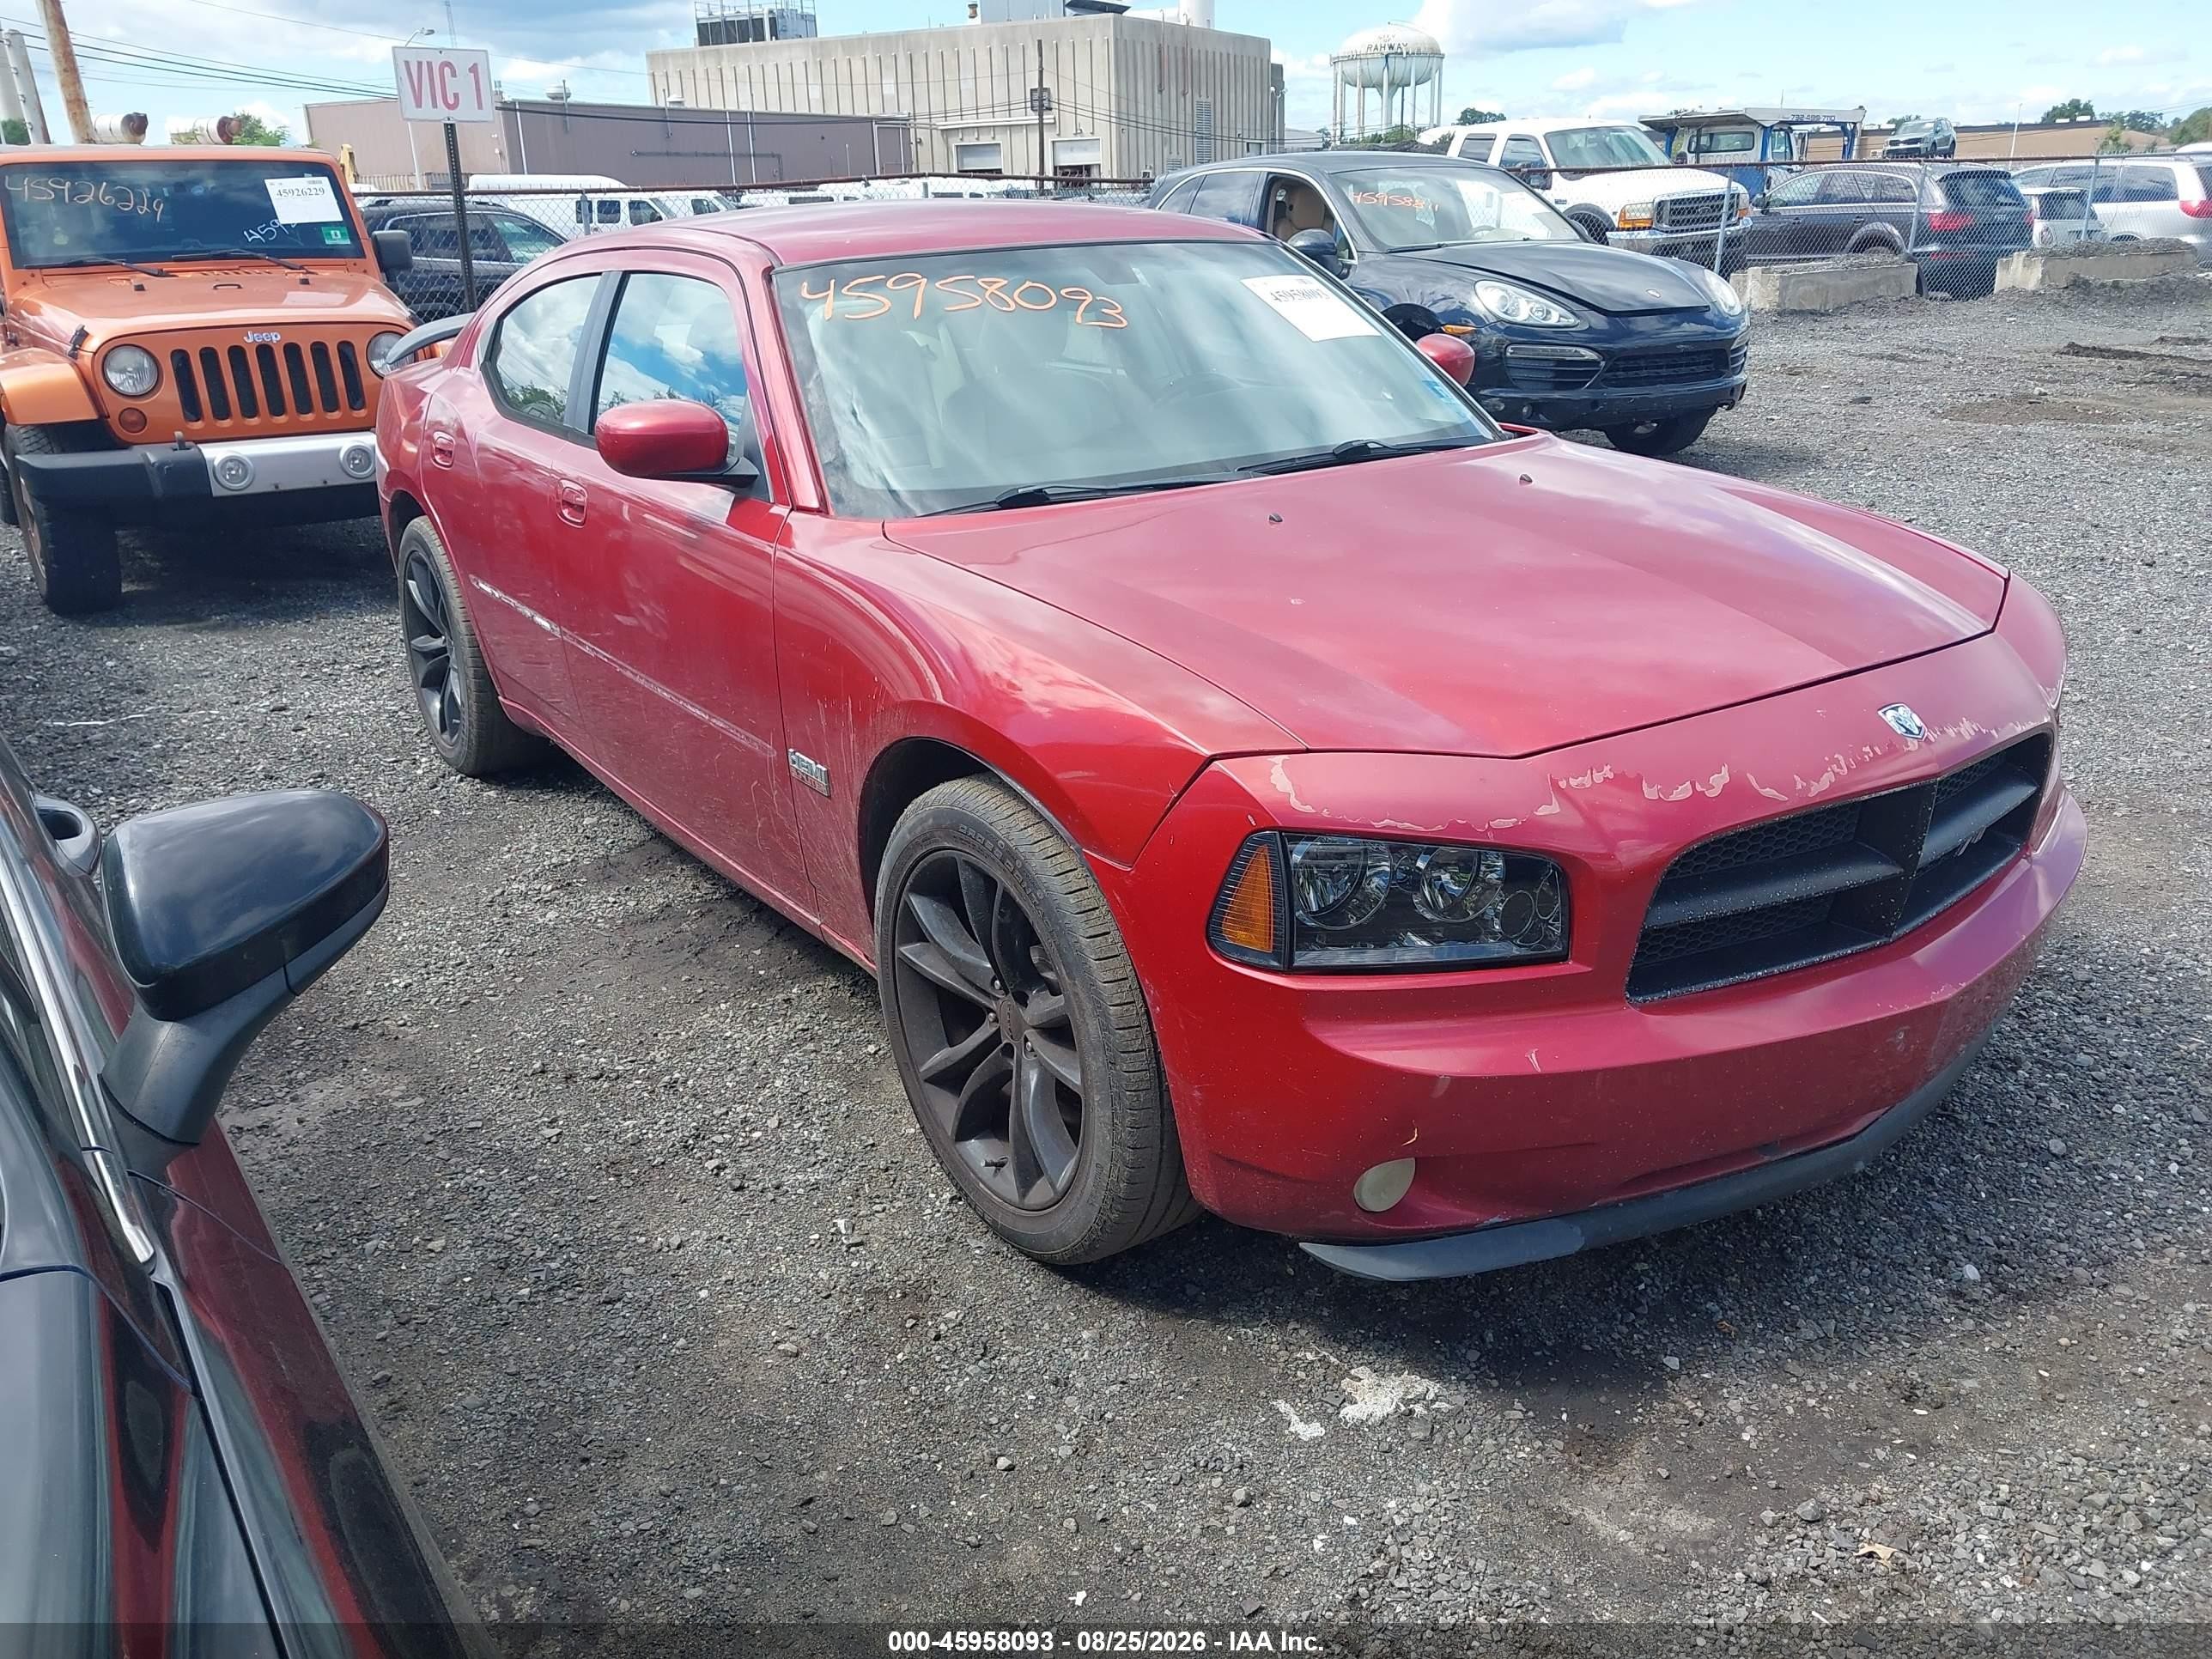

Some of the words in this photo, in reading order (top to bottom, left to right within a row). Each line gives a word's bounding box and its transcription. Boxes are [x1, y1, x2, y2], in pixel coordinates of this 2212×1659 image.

[1367, 42, 1408, 52] RAHWAY
[404, 60, 459, 111] VIC
[468, 63, 483, 111] 1
[5, 175, 164, 222] 45926229
[276, 187, 325, 198] 45926229
[243, 219, 298, 243] 459
[800, 272, 1128, 328] 45958093
[243, 330, 282, 343] Jeep
